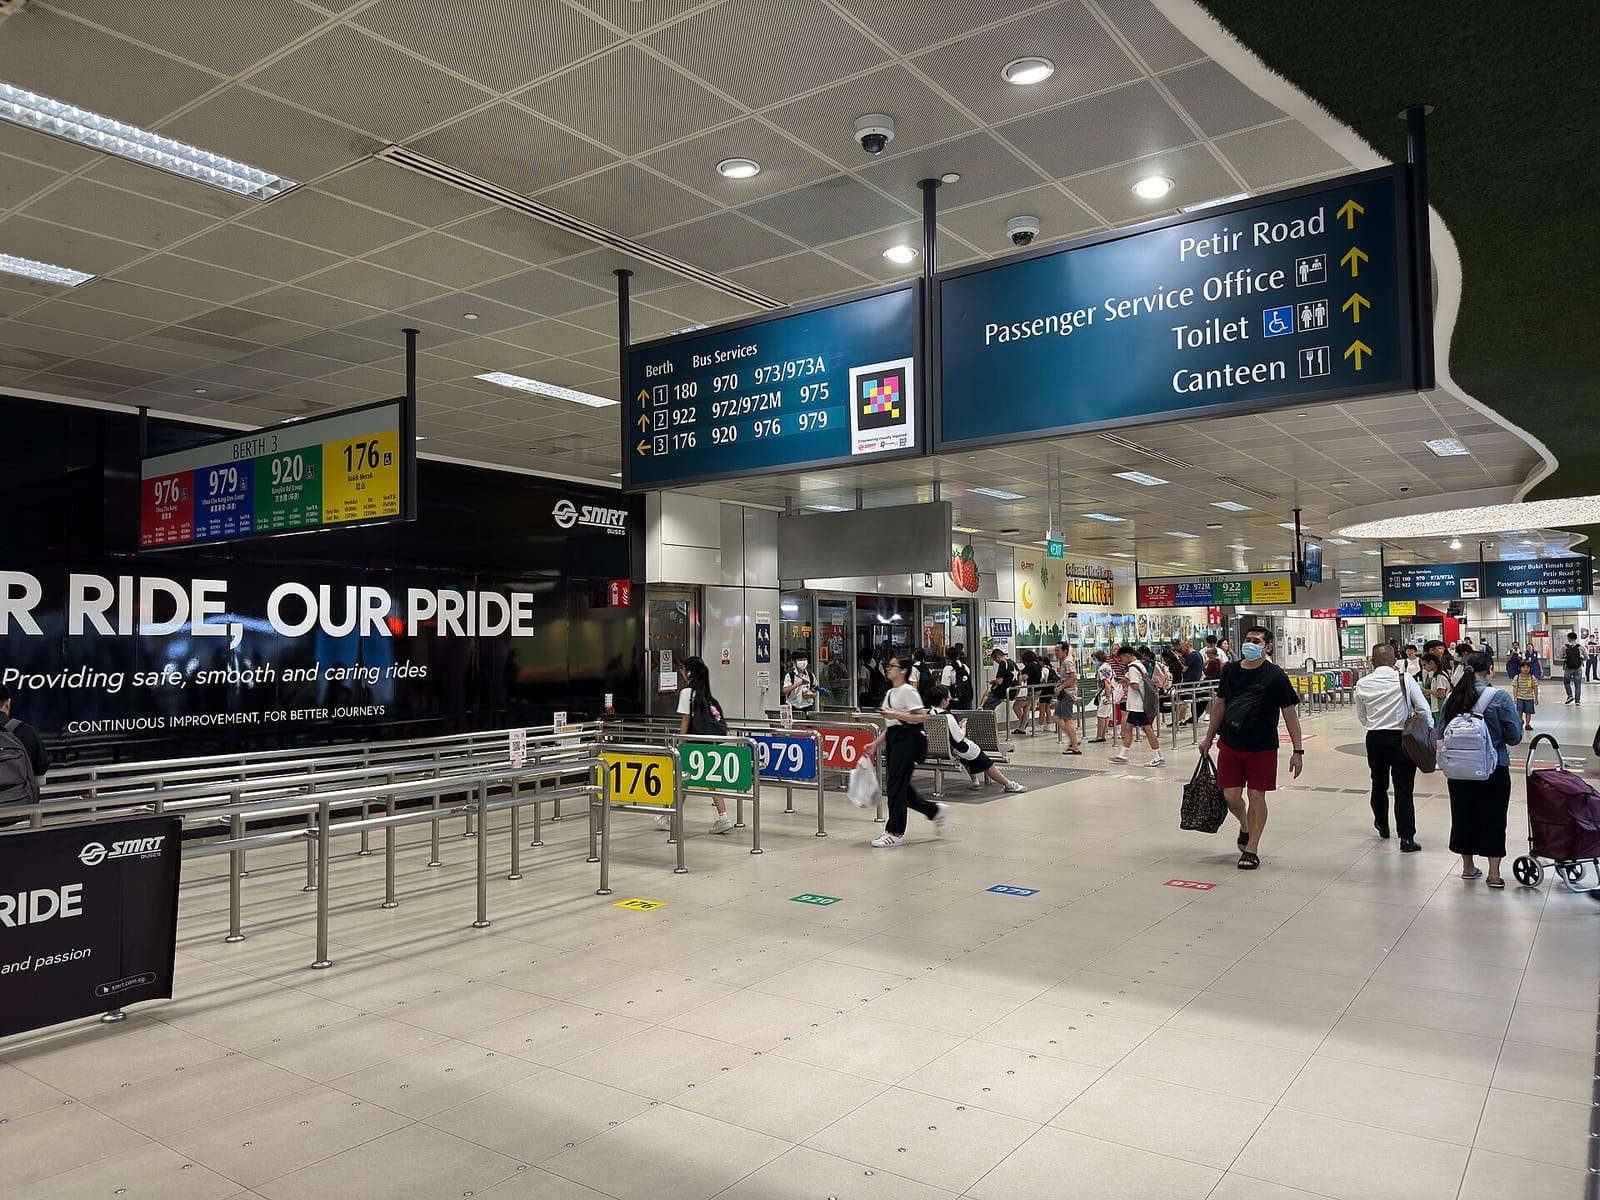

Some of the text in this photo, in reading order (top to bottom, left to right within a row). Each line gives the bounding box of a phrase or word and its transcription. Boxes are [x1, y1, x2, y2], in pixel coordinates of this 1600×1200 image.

[1179, 207, 1325, 262] Petir Road
[984, 267, 1285, 346] Passenger Service Office
[1171, 317, 1249, 351] Toilet
[645, 343, 758, 378] Berth Bus Services
[657, 356, 826, 402] 1 180 970 973/973A
[1172, 359, 1286, 394] Canteen
[657, 382, 829, 427] 2 922 972/972M 975
[657, 411, 828, 452] 3 176 920 976 979
[232, 435, 279, 460] BERTH 3
[343, 440, 380, 472] 176
[209, 467, 238, 496] 979
[271, 454, 304, 485] 920
[154, 478, 180, 505] 976
[579, 505, 628, 526] SMRT
[1066, 563, 1088, 577] Selamat
[1088, 565, 1100, 579] Hari
[1066, 579, 1114, 605] Aidilfitri
[1148, 585, 1166, 595] 975
[1177, 583, 1190, 591] 972
[1222, 582, 1241, 592] 922
[0, 570, 534, 650] R RIDE, OUR PRIDE
[2, 660, 428, 693] Providing safe, smooth and caring rides
[67, 705, 385, 734] CONTINUOUS IMPROVEMENT, FOR BETTER JOURNEYS
[609, 735, 857, 797] 176 920 979 76
[108, 836, 166, 856] SMRT
[994, 886, 1032, 896] 979
[1171, 880, 1209, 890] 976
[624, 899, 658, 909] 176
[799, 895, 835, 905] 920
[0, 946, 92, 975] and passion
[111, 977, 146, 991] smrt.com.sg
